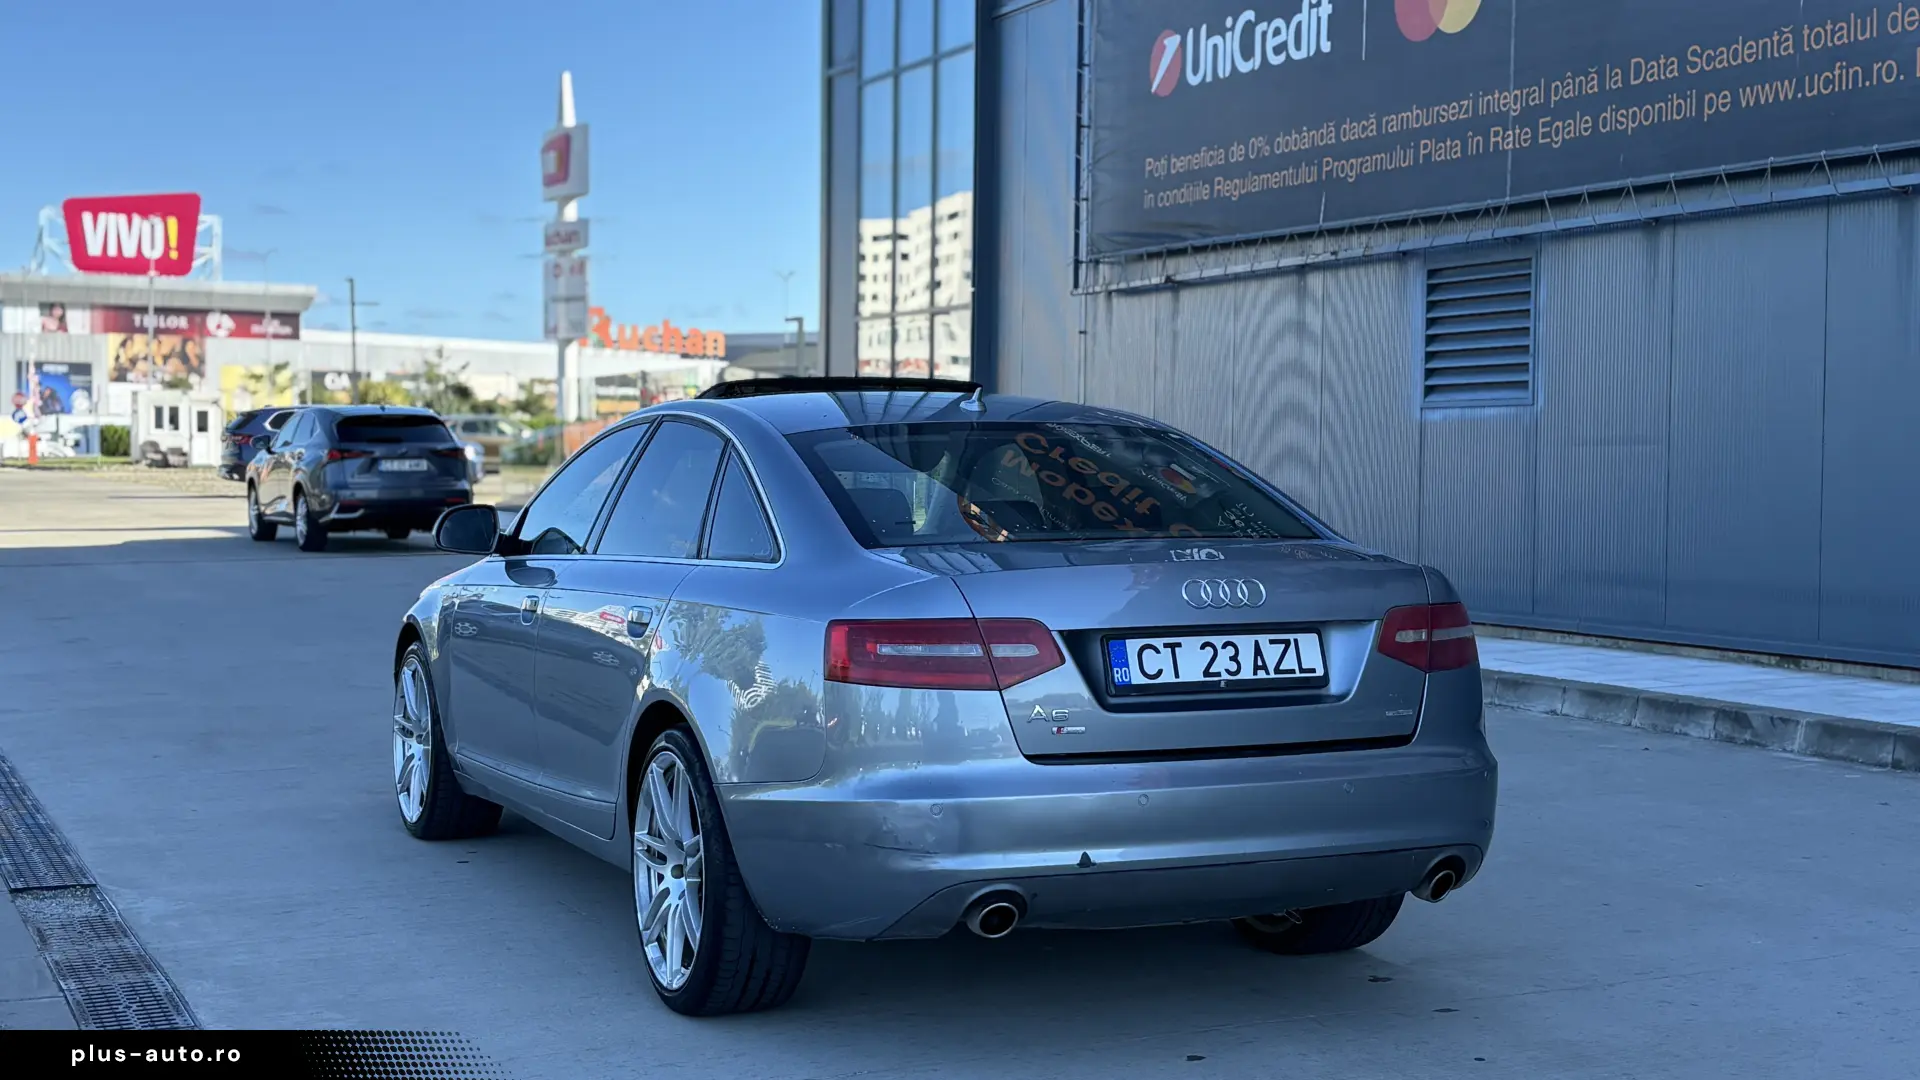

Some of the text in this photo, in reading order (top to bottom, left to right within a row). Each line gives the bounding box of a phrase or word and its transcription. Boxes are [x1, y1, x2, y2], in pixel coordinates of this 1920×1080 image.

[1186, 0, 1333, 86] UniCredit
[1171, 144, 1225, 174] beneficia
[1229, 141, 1245, 163] de
[1248, 135, 1270, 160] 0%
[1274, 120, 1336, 154] dobândă
[1340, 112, 1377, 142] dacă
[1382, 93, 1473, 134] rambursezi
[1479, 78, 1544, 116] integral
[1551, 66, 1598, 108] până
[1606, 63, 1623, 90] la
[1630, 54, 1678, 85] Data
[1687, 25, 1794, 74] Scadentă
[1803, 7, 1877, 51] totalul
[1887, 2, 1920, 35] de
[1157, 180, 1210, 207] condițiile
[1214, 160, 1317, 200] Regulamentului
[1323, 142, 1414, 182] Programului
[1420, 138, 1461, 164] Plata
[1467, 131, 1483, 156] în
[1490, 124, 1532, 152] Rate
[1538, 111, 1592, 148] Egale
[1600, 89, 1696, 135] disponibil
[1704, 90, 1731, 122] pe
[1739, 59, 1905, 108] www.ucfin.ro.
[81, 210, 179, 260] VIVO!
[578, 306, 726, 358] Auchan
[1113, 638, 1317, 684] RO CT 23 AZL
